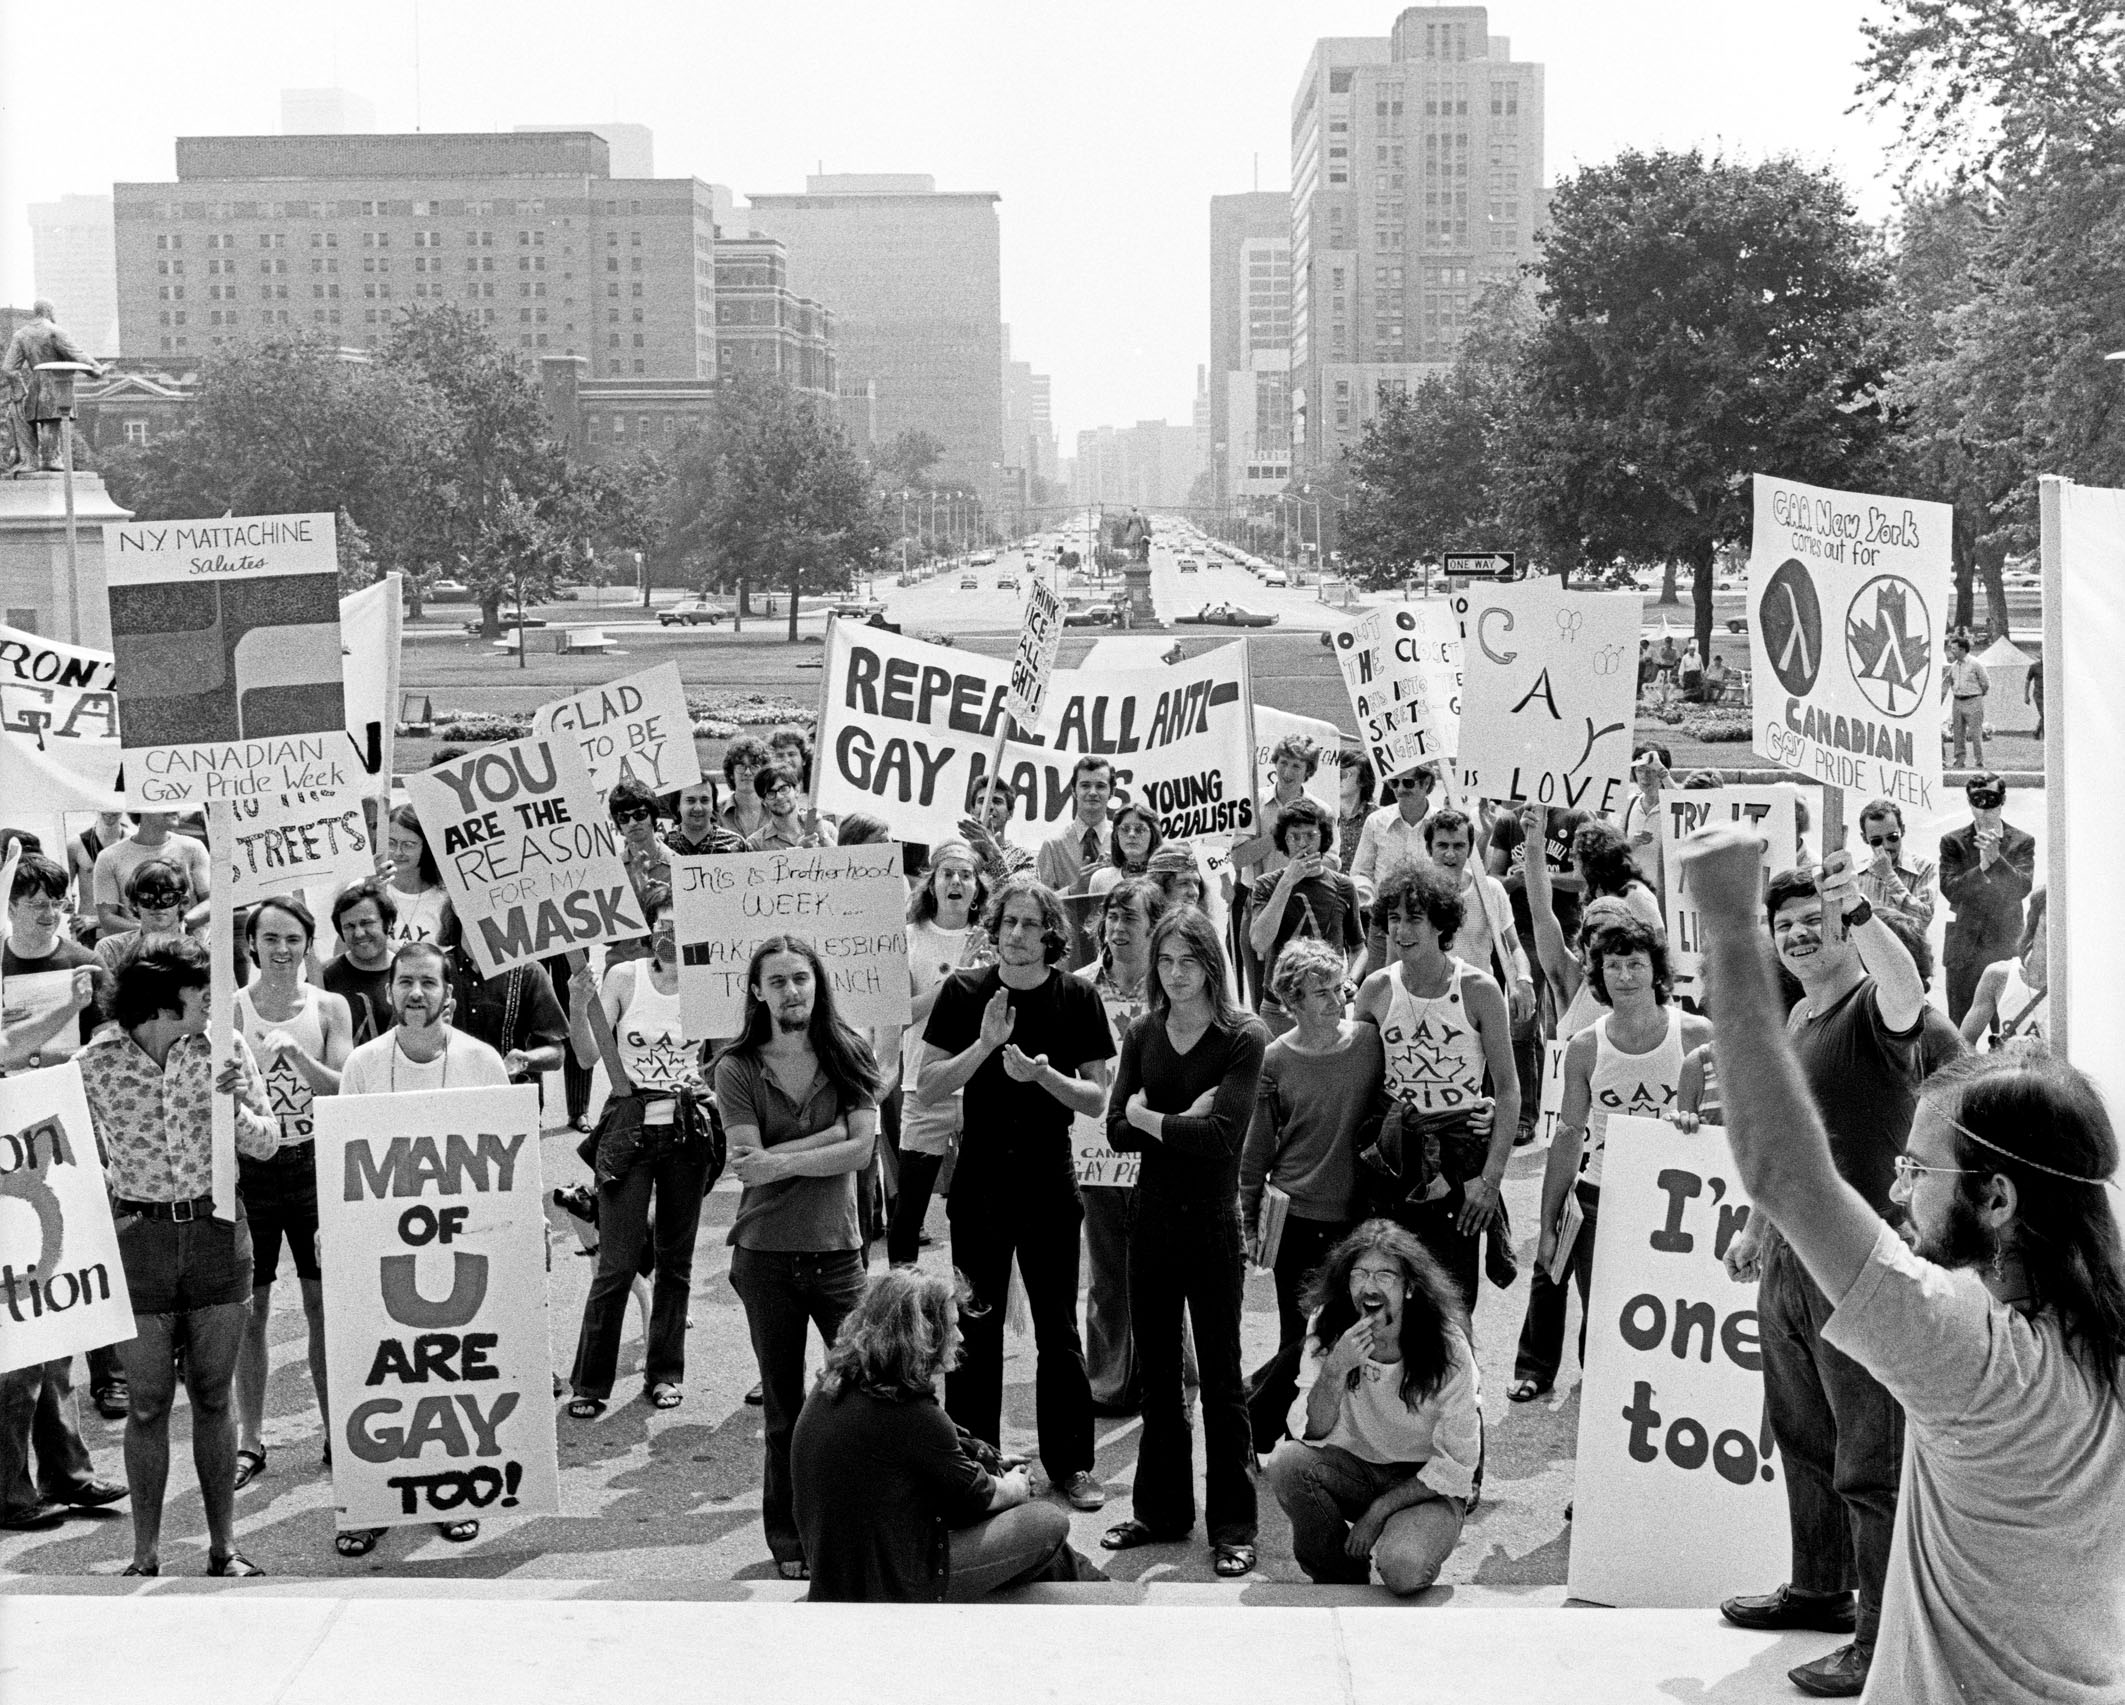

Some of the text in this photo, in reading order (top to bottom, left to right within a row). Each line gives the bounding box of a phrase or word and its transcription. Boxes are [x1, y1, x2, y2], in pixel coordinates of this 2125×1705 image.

[177, 520, 313, 550] MATTACHINE
[1815, 499, 1860, 539] New
[1865, 506, 1919, 548] York
[1450, 559, 1496, 569] ONE WAY
[1792, 532, 1880, 566] comes out for
[1337, 613, 1380, 650] OUT
[1396, 609, 1427, 633] OF
[1018, 634, 1039, 673] ALL
[1342, 646, 1385, 686] THE
[1011, 659, 1042, 713] GHT!
[1393, 676, 1428, 701] INTO
[551, 686, 642, 733] GLAD
[1054, 695, 1141, 754] ALL
[1145, 678, 1239, 750] ANTI-
[1368, 700, 1430, 742] STREETS
[1785, 697, 1914, 767] CANADIAN
[145, 738, 323, 774] CANADIAN
[580, 715, 667, 762] TO BE
[1372, 728, 1440, 778] RIGHTS
[142, 762, 345, 801] Gay Pride Week
[433, 742, 557, 815] YOU
[587, 741, 670, 790] AY
[836, 724, 955, 807] GAY
[1816, 747, 1867, 792] PRIDE
[1879, 765, 1933, 810] WEEK
[1142, 769, 1223, 815] YOUNG
[1511, 767, 1622, 813] LOVE
[444, 810, 506, 856] ARE
[513, 798, 572, 829] THE
[1160, 797, 1253, 840] OCIALISTS
[232, 811, 366, 884] TREETS
[454, 821, 616, 891] REASON
[489, 867, 587, 910] FOR MY
[683, 854, 899, 894] This is Brotherhood
[477, 885, 643, 966] MASK
[811, 933, 908, 958] LESBIAN
[829, 966, 882, 994] NCH
[627, 1031, 701, 1051] GAY
[1384, 1020, 1464, 1045] GAY
[1385, 1077, 1480, 1108] PRIDE
[1600, 1082, 1678, 1107] GAY
[343, 1133, 527, 1201] MANY
[397, 1204, 470, 1247] OF
[380, 1251, 489, 1330] U
[1619, 1293, 1764, 1371] one
[365, 1333, 500, 1386] ARE
[345, 1391, 521, 1464] GAY
[1621, 1380, 1776, 1486] too!
[387, 1460, 523, 1514] TOO!
